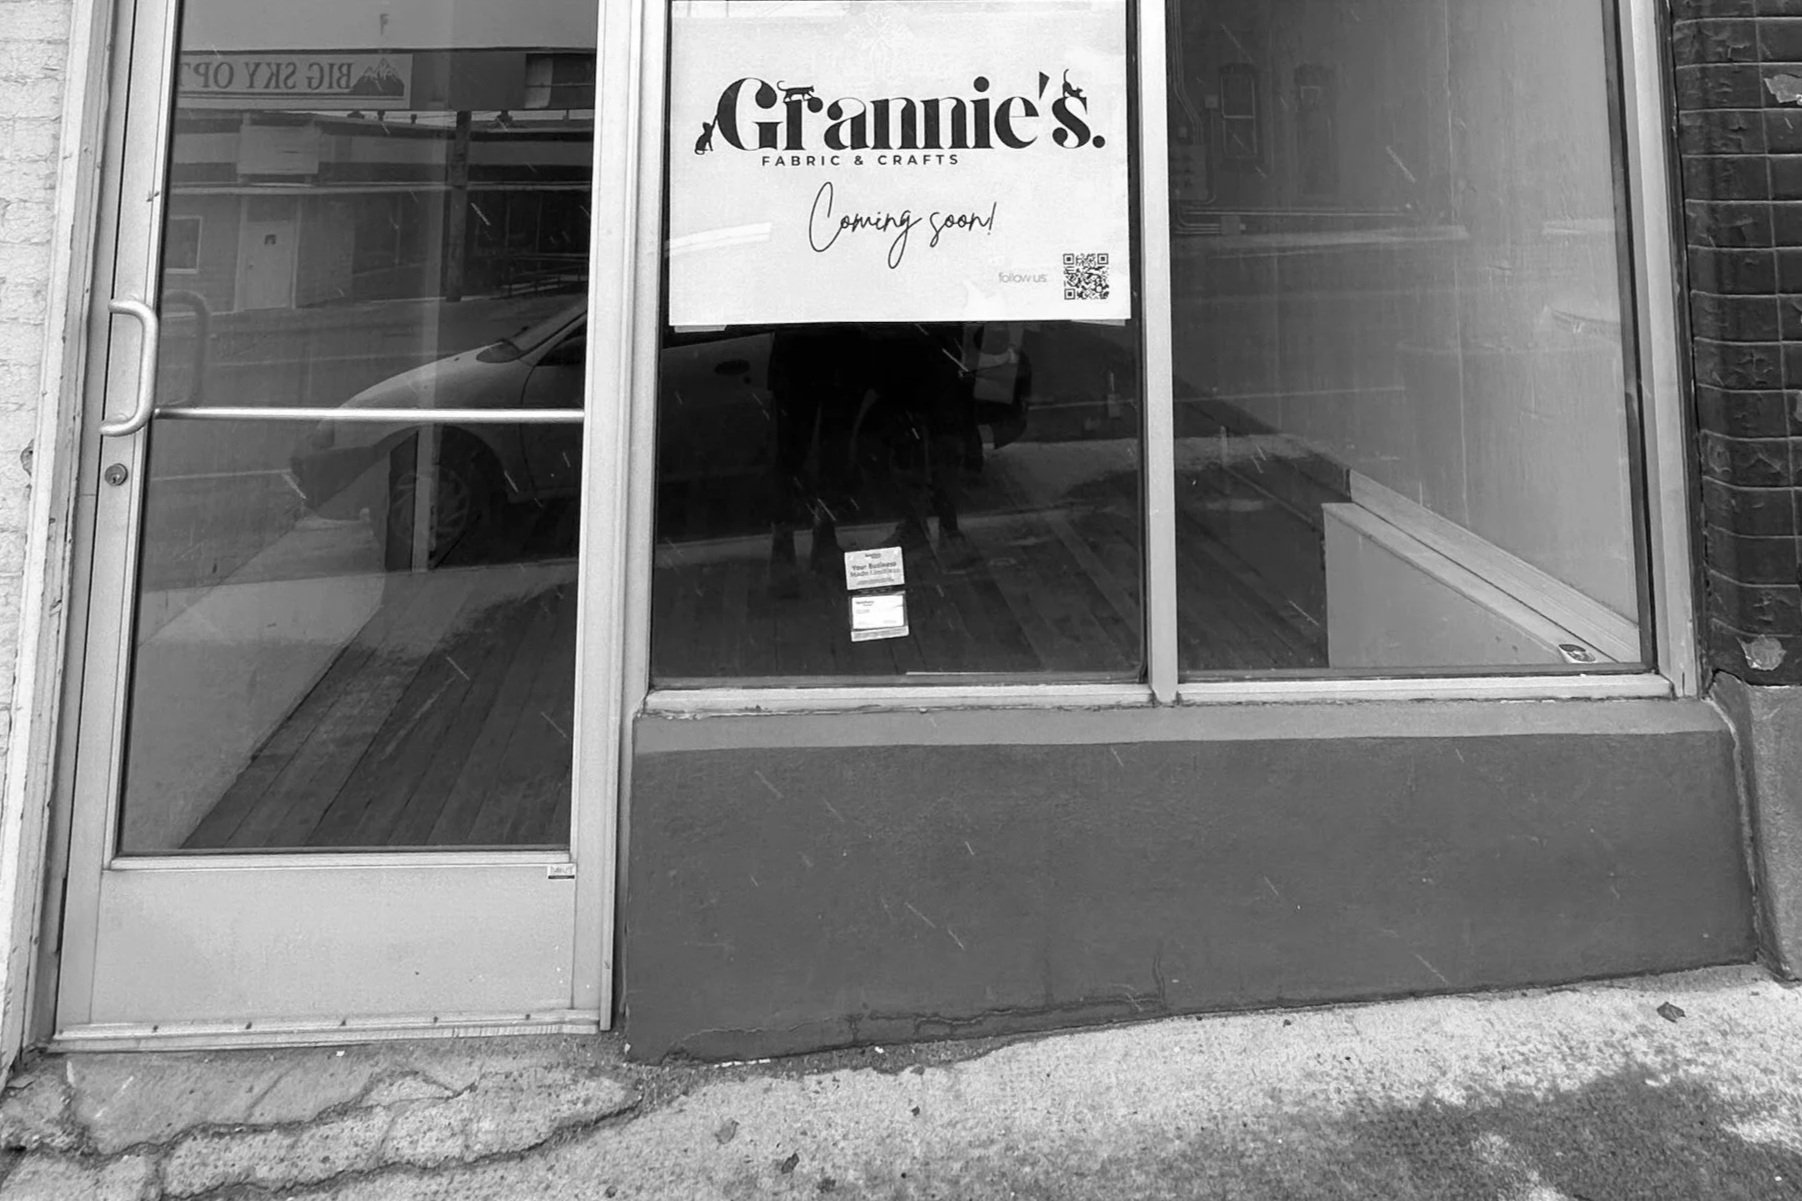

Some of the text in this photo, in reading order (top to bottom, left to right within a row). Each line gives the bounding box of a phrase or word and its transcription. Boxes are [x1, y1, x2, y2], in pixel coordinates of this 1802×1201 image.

[716, 71, 1106, 151] Grannie's.
[761, 153, 959, 167] FABRIC & CRAFTS
[808, 181, 997, 270] Coming soon!
